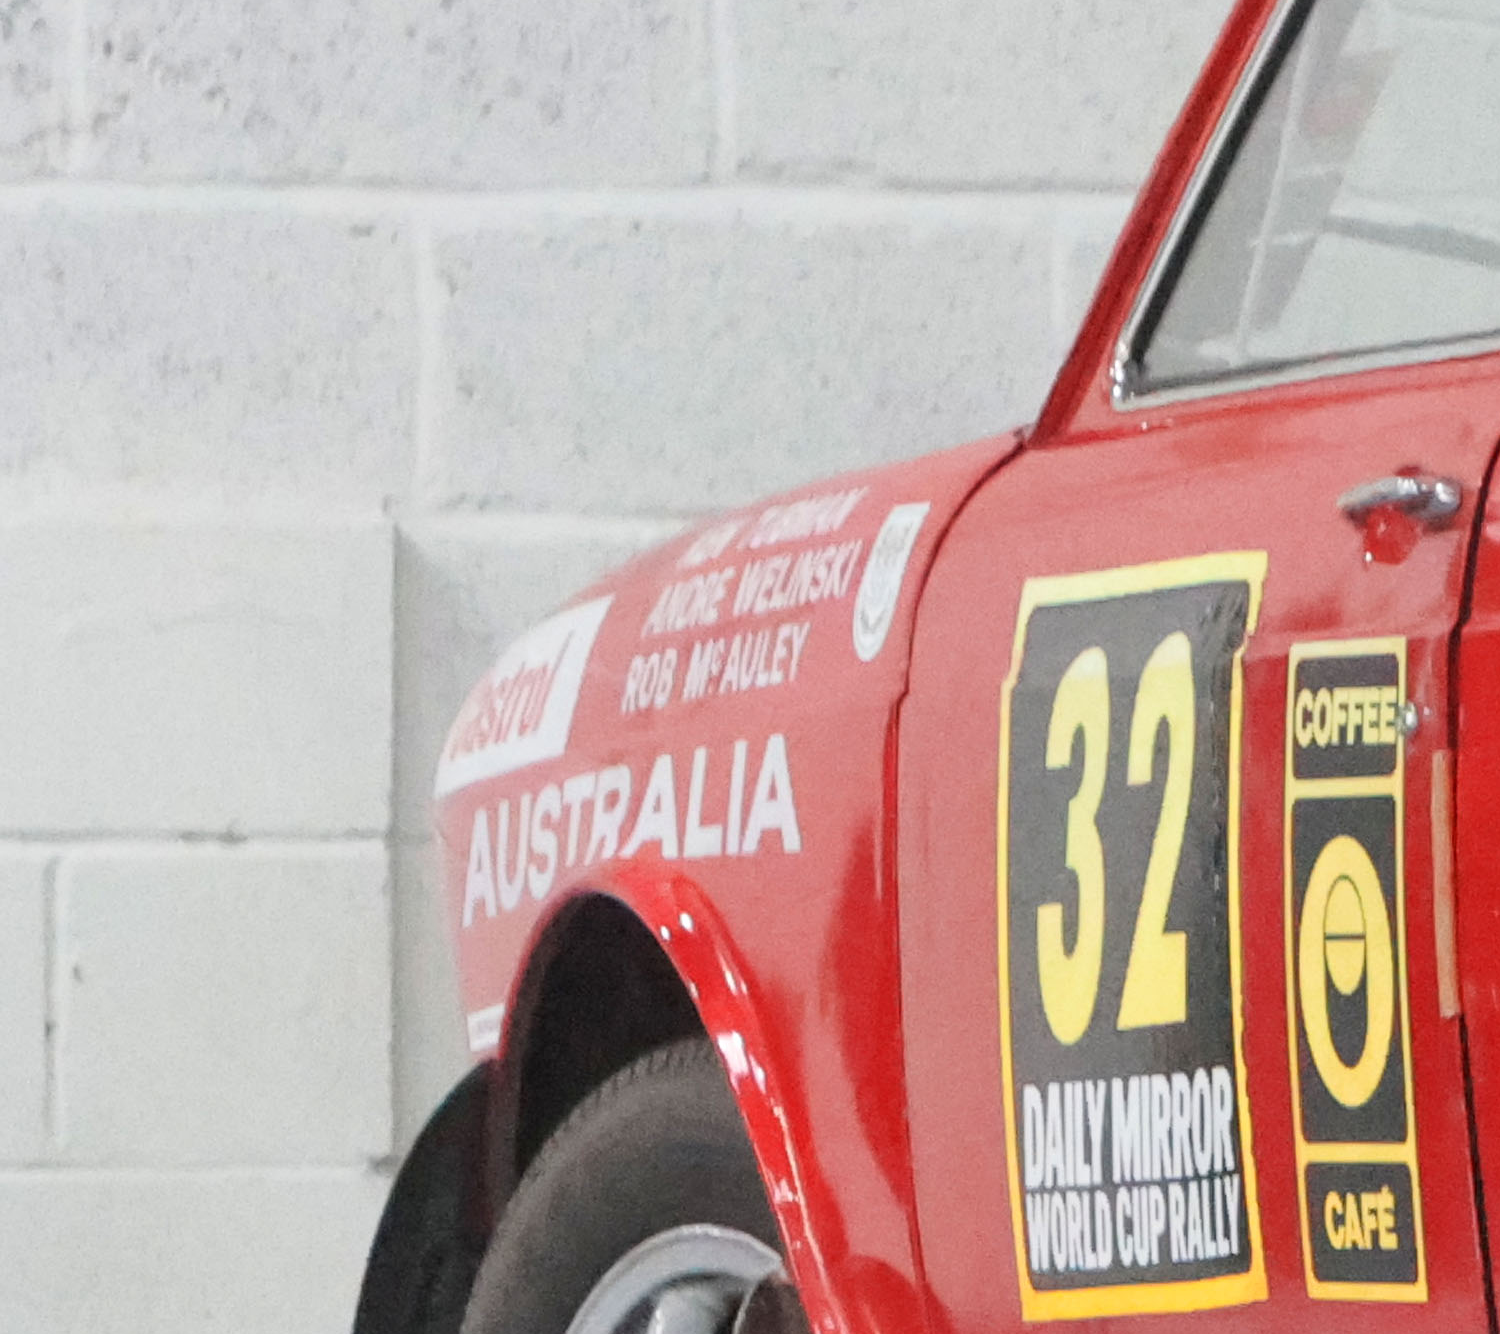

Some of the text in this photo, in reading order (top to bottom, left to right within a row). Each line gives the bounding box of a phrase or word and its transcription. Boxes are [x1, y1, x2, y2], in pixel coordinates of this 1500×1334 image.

[620, 647, 679, 715] ROB
[1295, 685, 1397, 749] COFFEE
[462, 732, 803, 929] AUSTRALIA
[1036, 631, 1196, 1046] 32
[1022, 1064, 1236, 1189] DAILY MIRROR
[1025, 1173, 1240, 1273] WORLD CUP RALLY
[1324, 1183, 1398, 1252] CAFÉ
